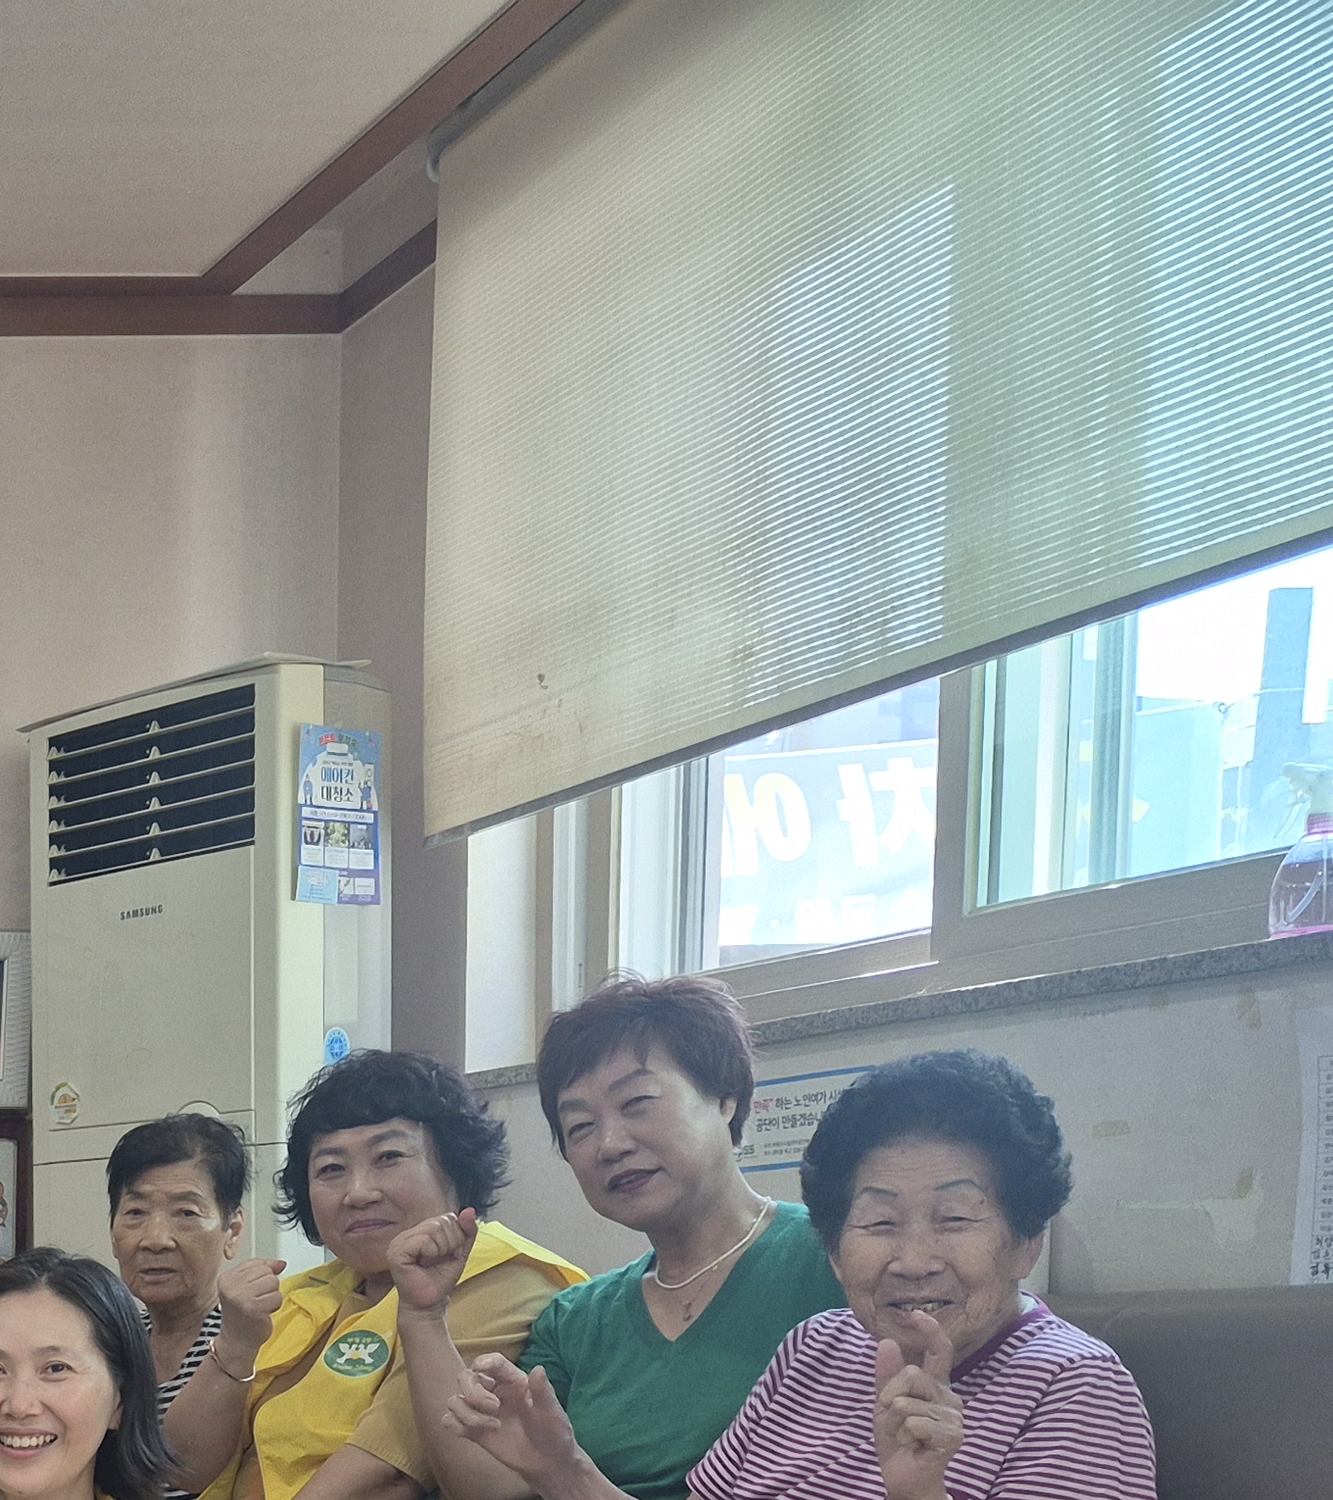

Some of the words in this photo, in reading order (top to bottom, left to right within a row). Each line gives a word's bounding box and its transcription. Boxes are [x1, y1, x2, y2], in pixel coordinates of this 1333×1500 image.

[320, 766, 355, 784] 에어컨
[321, 786, 354, 803] 대청소
[120, 904, 164, 921] SAMSUNG
[775, 1097, 792, 1110] 하는
[756, 1119, 780, 1133] 공단이
